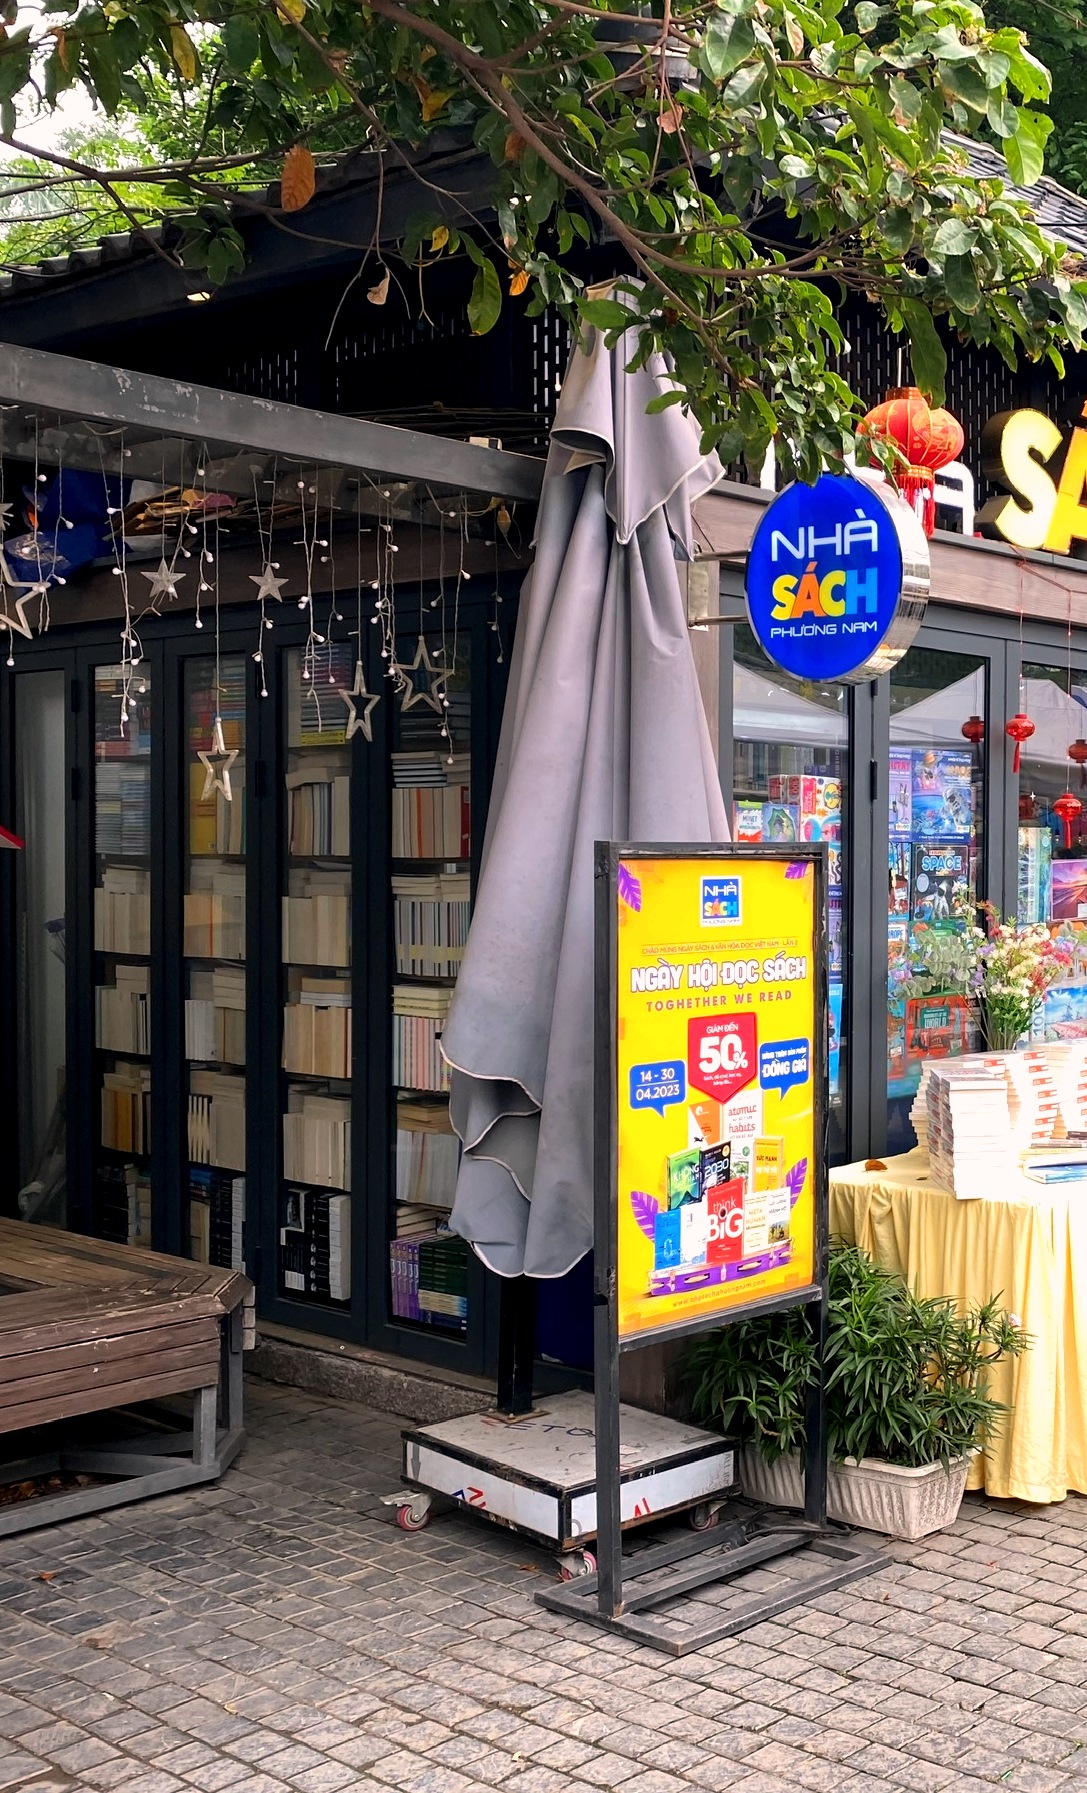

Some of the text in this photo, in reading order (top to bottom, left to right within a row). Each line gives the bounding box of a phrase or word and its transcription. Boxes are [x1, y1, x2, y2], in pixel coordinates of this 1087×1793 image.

[771, 508, 879, 562] NHÀ
[770, 561, 879, 621] SÁCH
[770, 621, 878, 639] PHƯƠNG NAM
[921, 855, 962, 871] SPACE
[704, 881, 737, 896] NHÀ
[704, 898, 737, 917] SÁCH
[695, 943, 710, 951] SÁCH
[631, 951, 807, 993] NGÀY HỘI ĐỌC SÁCH
[646, 990, 792, 1012] TOGHETHER WE READ
[699, 1034, 748, 1073] 50%
[762, 1053, 807, 1078] ĐỒNG GIÁ
[640, 1070, 652, 1082] 14
[661, 1068, 675, 1080] 30
[636, 1084, 680, 1101] 04.2023
[728, 1105, 757, 1116] atomic
[729, 1123, 756, 1133] habits
[705, 1158, 729, 1178] 2030
[713, 1195, 737, 1213] think
